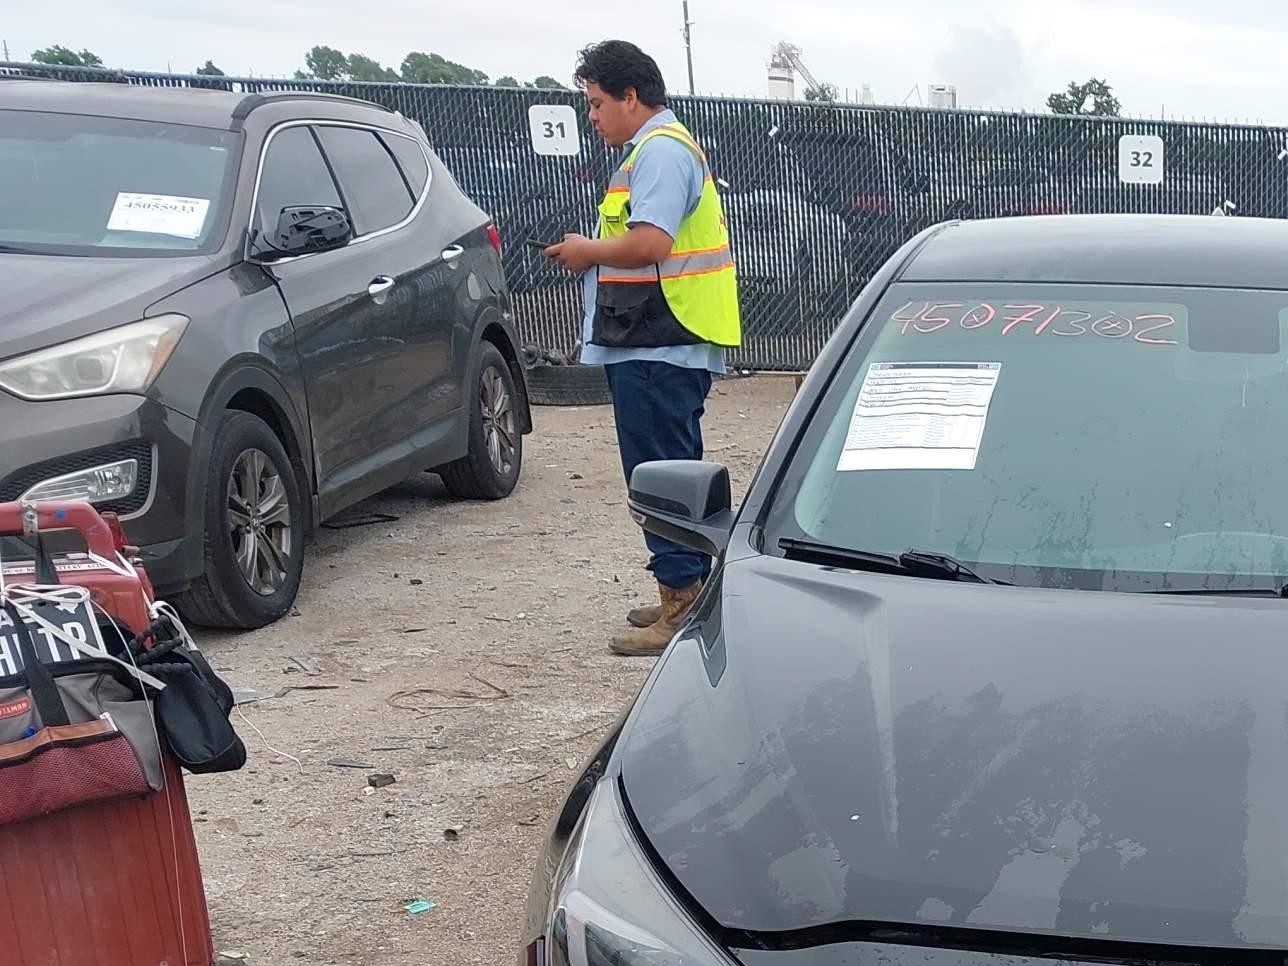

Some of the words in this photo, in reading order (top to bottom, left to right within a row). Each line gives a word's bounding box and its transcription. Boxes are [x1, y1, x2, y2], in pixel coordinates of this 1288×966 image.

[542, 121, 566, 138] 31
[1130, 151, 1153, 167] 32
[891, 302, 1178, 345] 45071302
